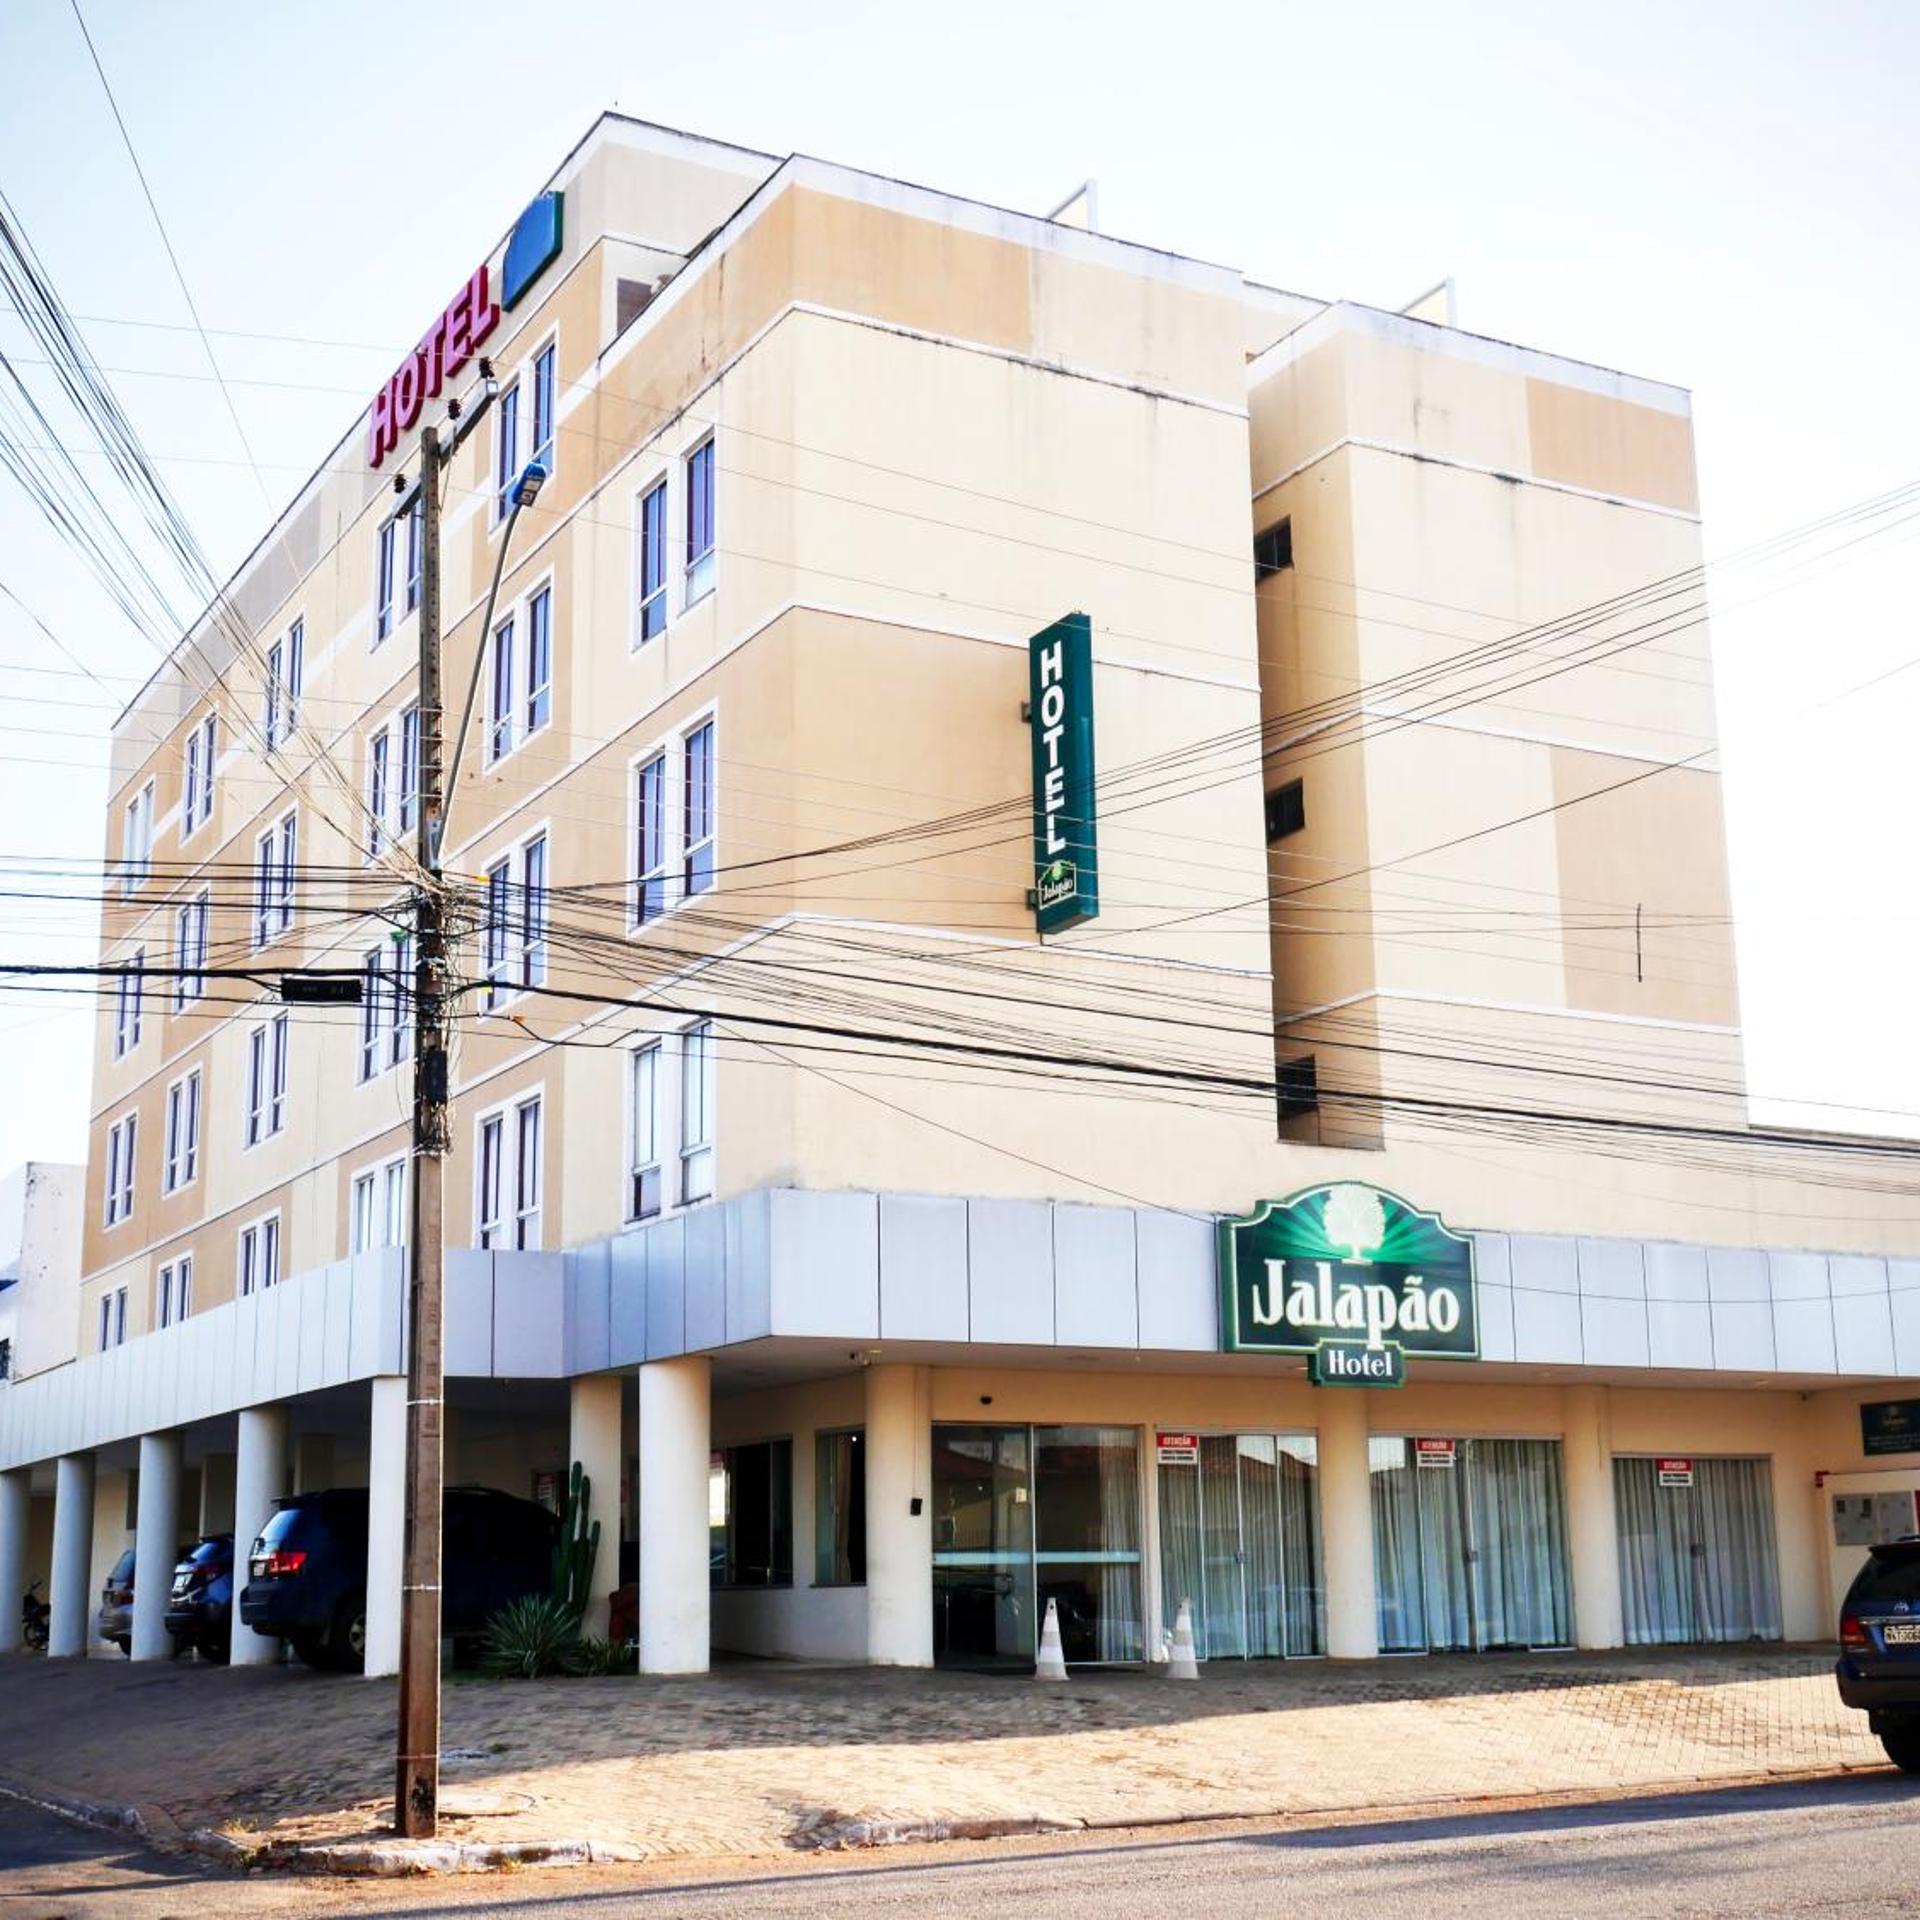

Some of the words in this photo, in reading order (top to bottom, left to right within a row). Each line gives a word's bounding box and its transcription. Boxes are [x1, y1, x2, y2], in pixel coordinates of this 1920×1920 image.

[369, 264, 500, 469] HOTEL
[1040, 640, 1066, 856] HOTEL
[1252, 1258, 1460, 1351] Jalapão
[1328, 1350, 1393, 1377] Hotel
